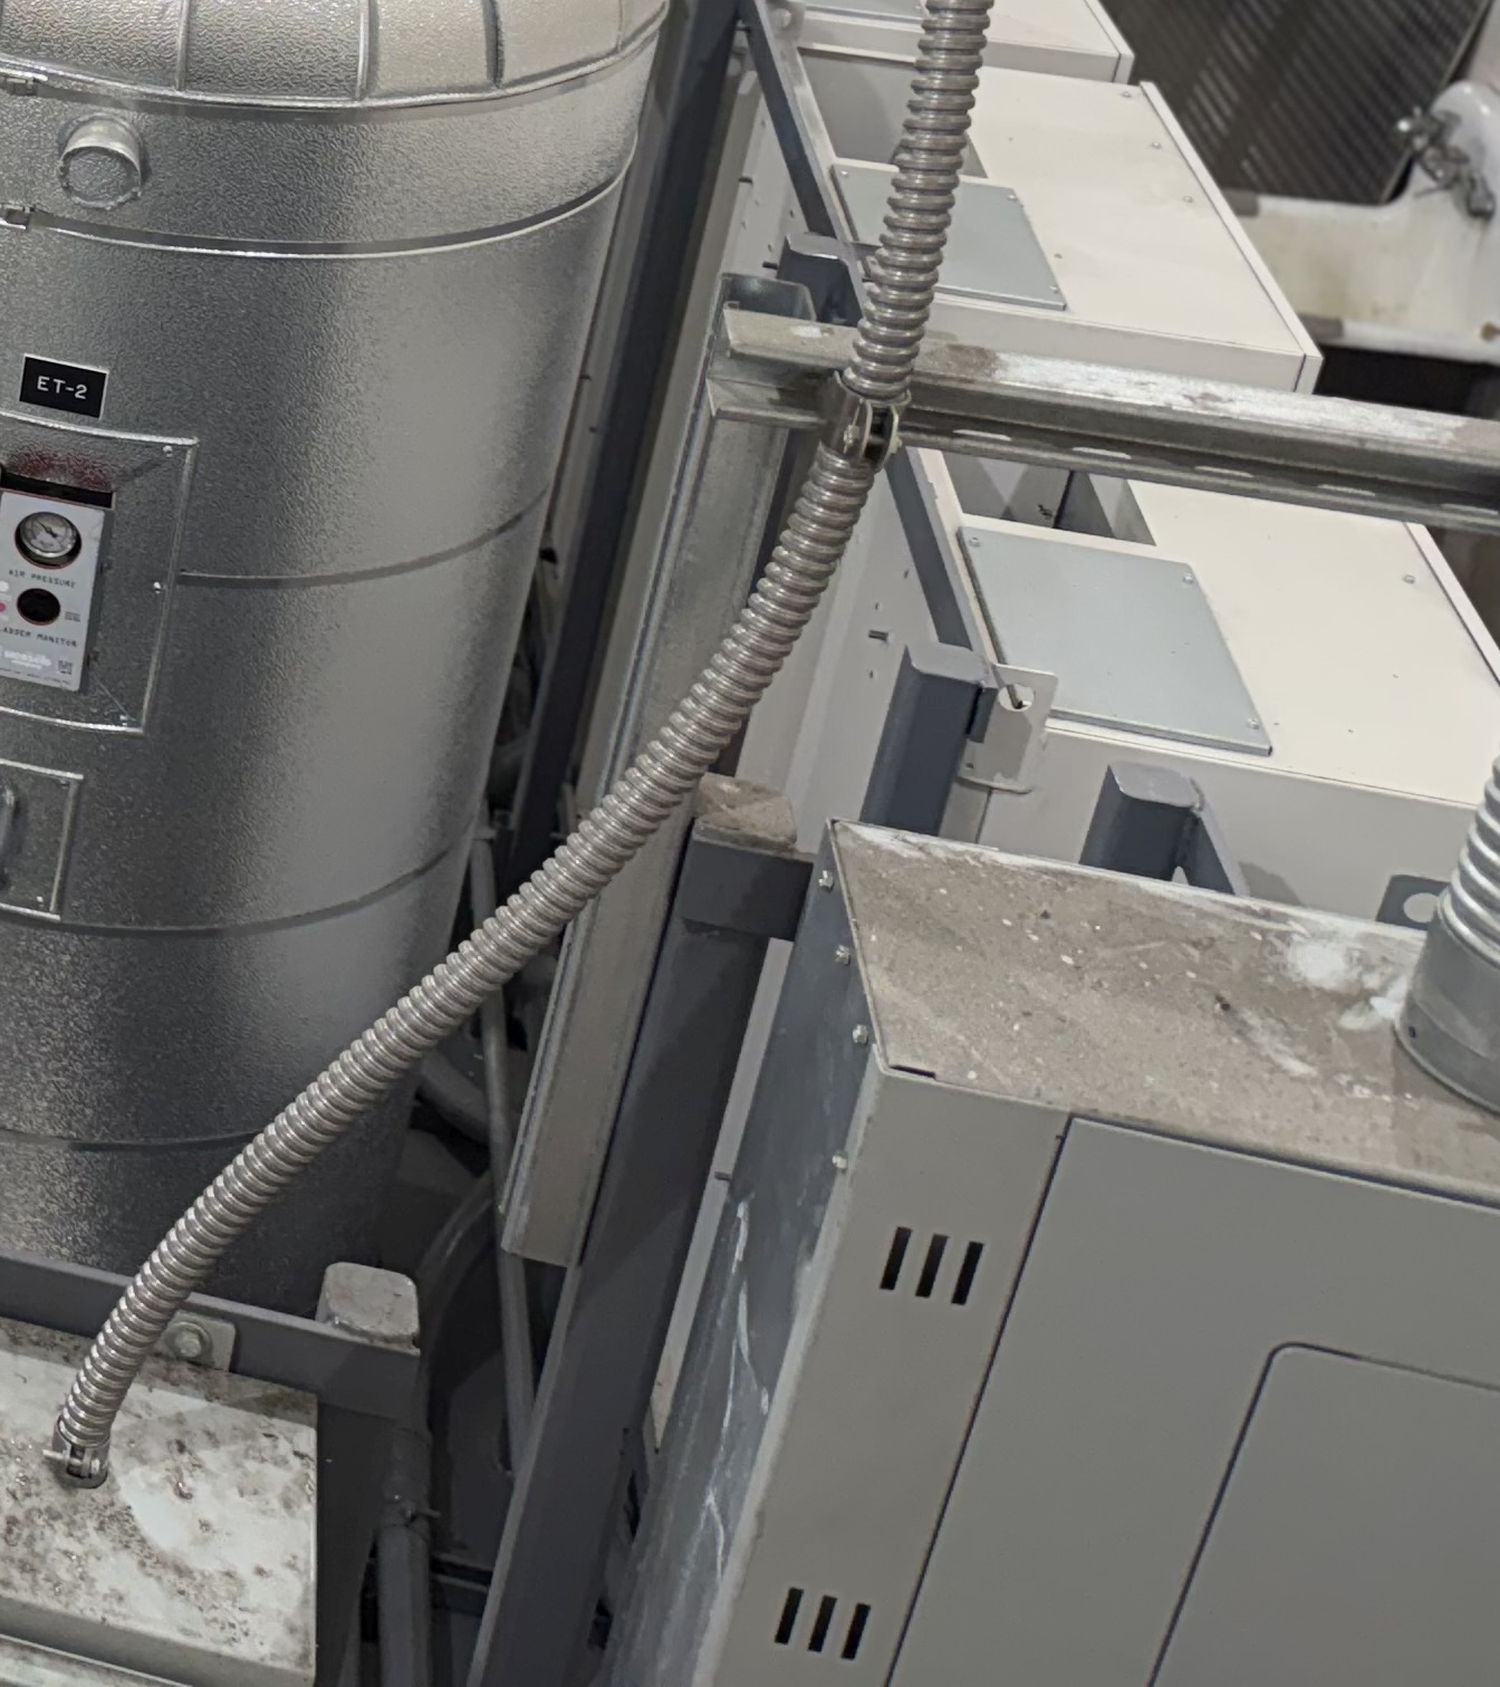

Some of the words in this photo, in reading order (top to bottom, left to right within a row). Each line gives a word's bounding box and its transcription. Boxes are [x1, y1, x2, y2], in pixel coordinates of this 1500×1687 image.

[36, 375, 88, 400] ET-2
[8, 568, 26, 578] AIR
[30, 572, 77, 589] PRESSURE
